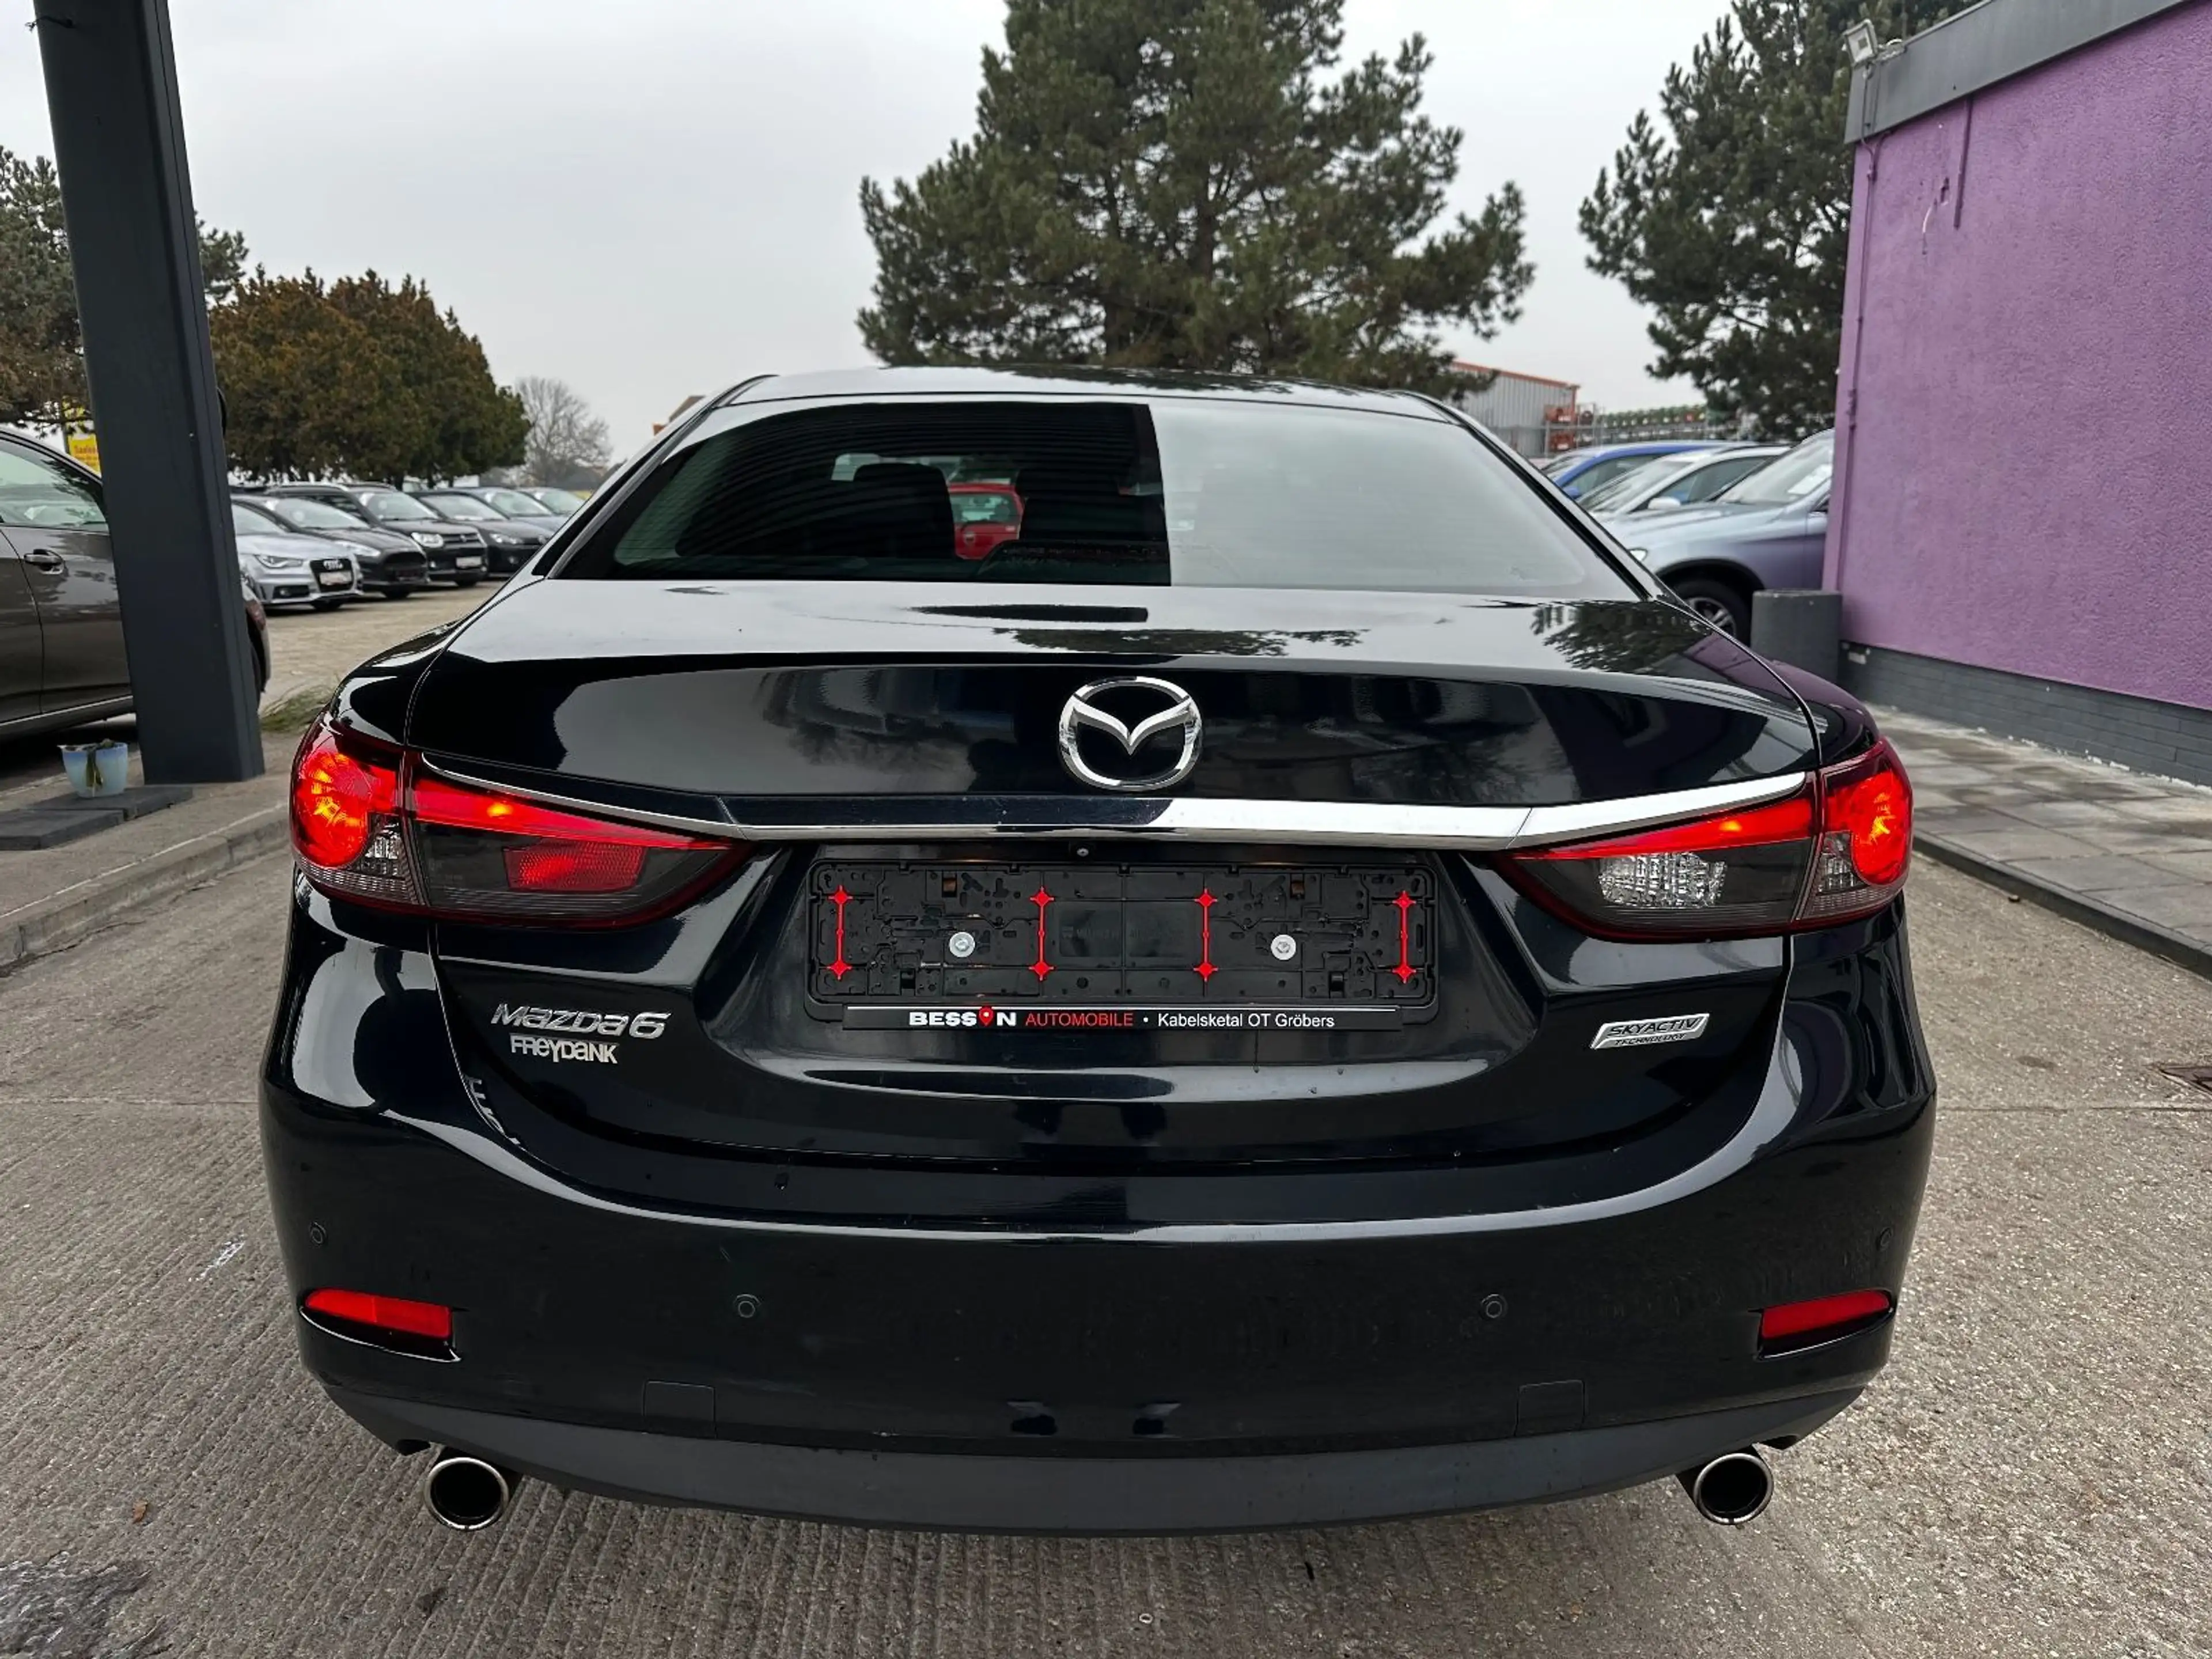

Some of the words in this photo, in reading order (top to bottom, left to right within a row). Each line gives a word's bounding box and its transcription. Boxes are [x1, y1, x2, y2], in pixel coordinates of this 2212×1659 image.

[1025, 1013, 1134, 1027] AUTOMOBILE
[1157, 1012, 1243, 1028] Kabelsketal
[1248, 1013, 1271, 1028] OT
[1275, 1012, 1335, 1028] Gröbers
[1607, 1018, 1699, 1037] SKYACTIV
